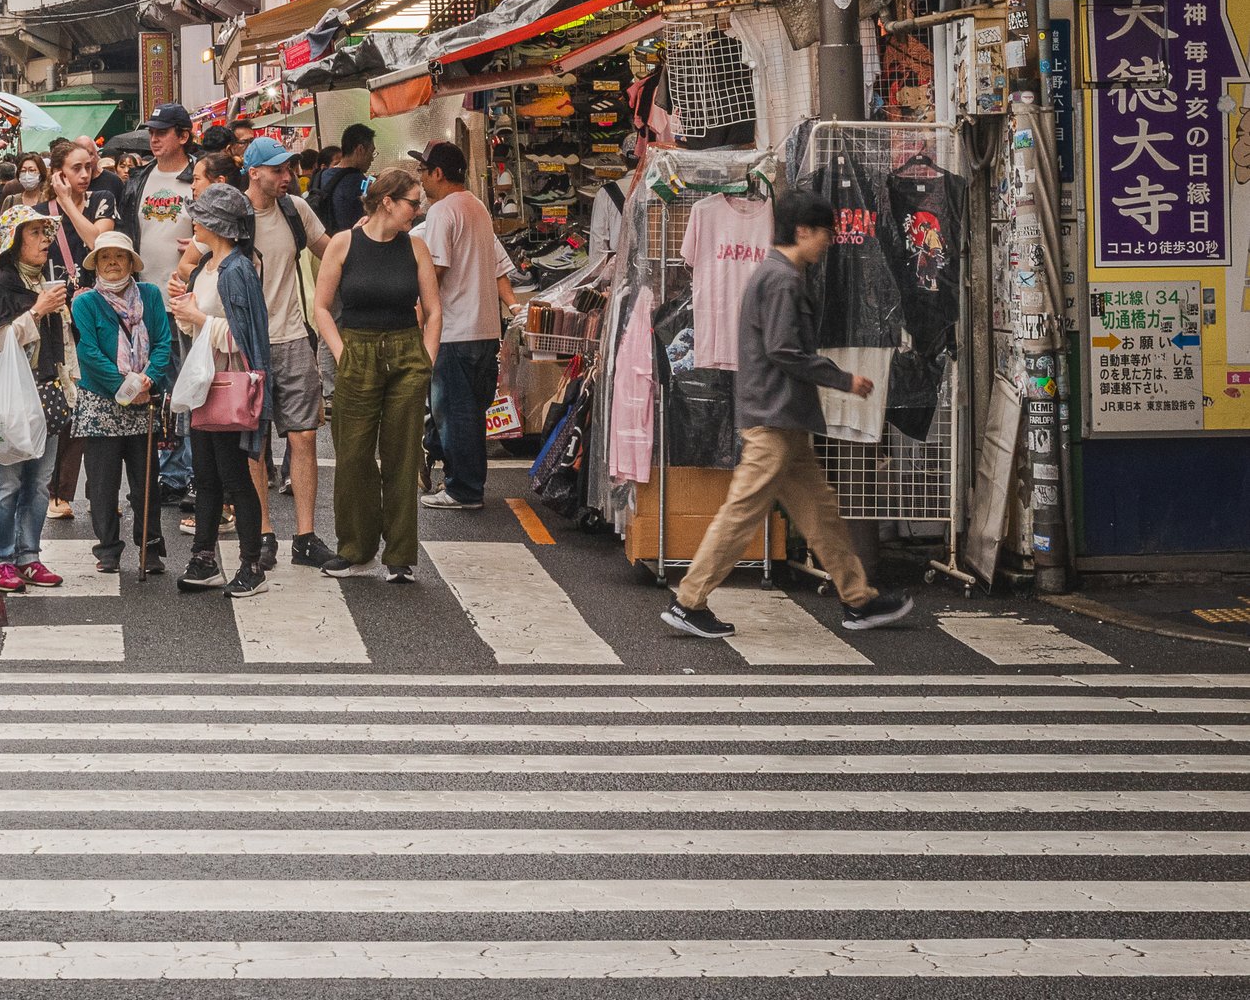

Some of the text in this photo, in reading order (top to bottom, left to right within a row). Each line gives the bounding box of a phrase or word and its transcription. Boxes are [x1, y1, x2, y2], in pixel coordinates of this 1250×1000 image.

[717, 244, 765, 263] JAPAN
[1107, 241, 1219, 256] ココより徒歩30秒
[1122, 336, 1171, 350] お願い
[1100, 367, 1194, 380] のを見た方は、至急
[1031, 403, 1053, 412] KEME
[1100, 402, 1141, 412] JR東日本
